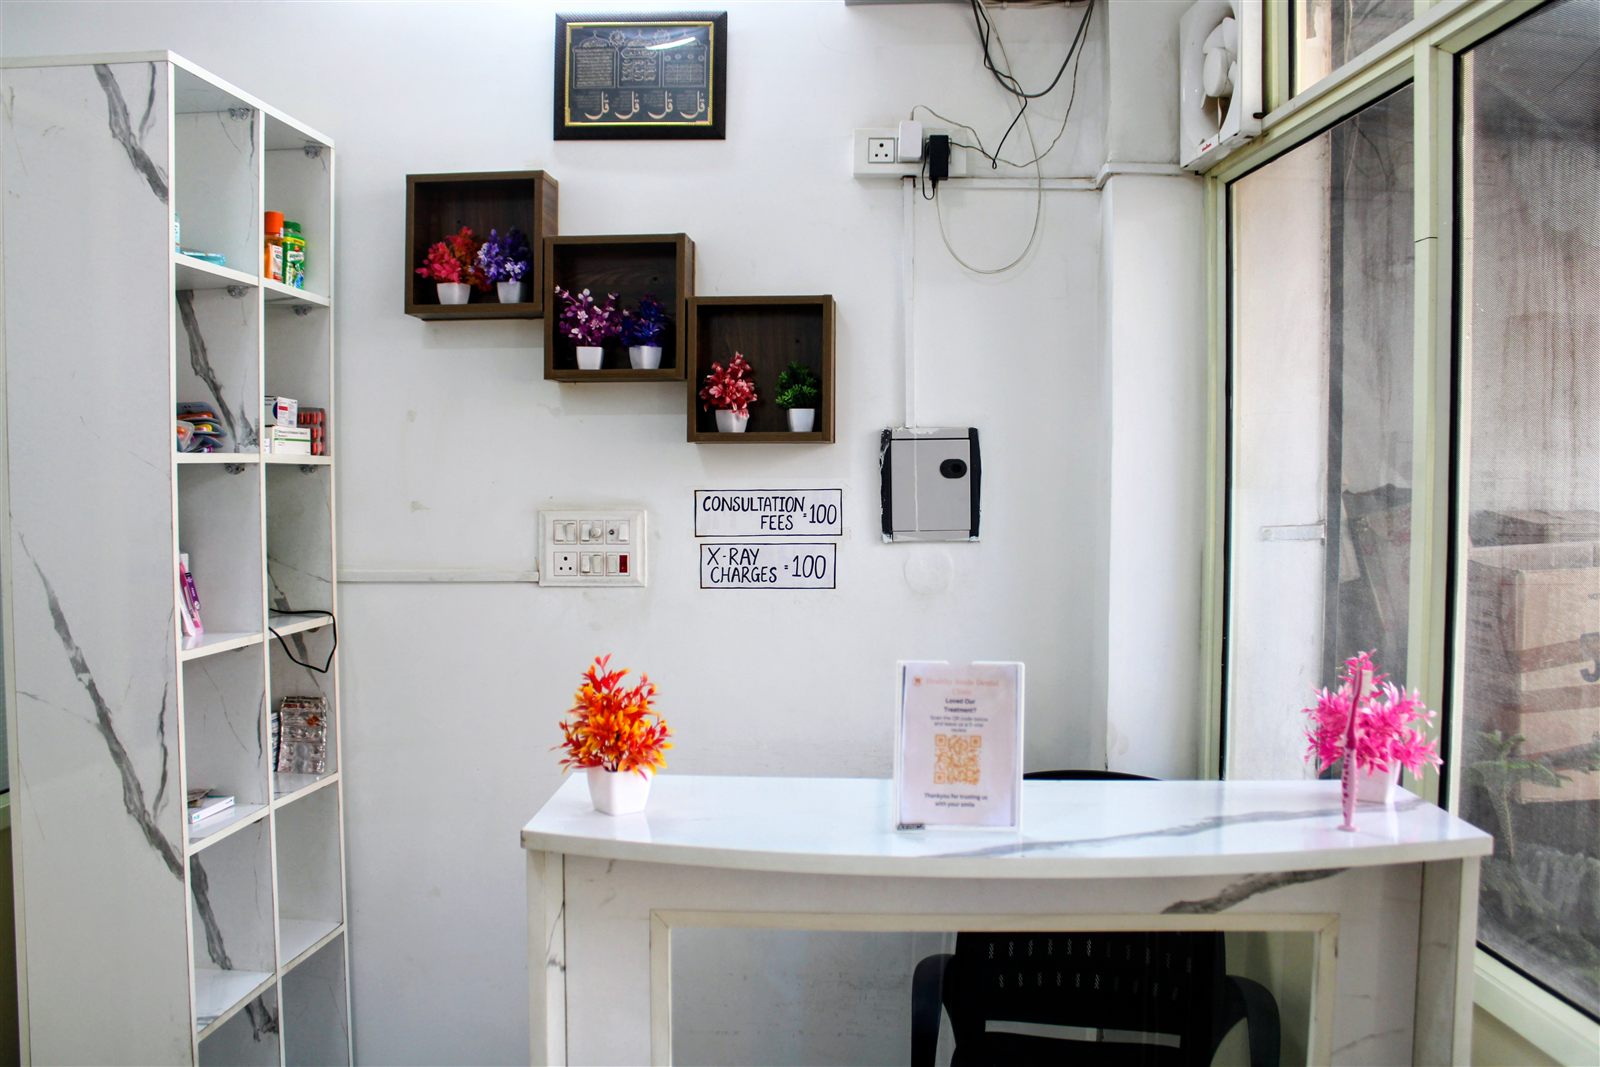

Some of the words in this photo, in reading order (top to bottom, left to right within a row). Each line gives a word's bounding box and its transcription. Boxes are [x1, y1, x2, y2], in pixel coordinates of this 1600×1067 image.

[702, 496, 805, 512] CONSULTATION
[760, 514, 793, 530] FEES
[707, 547, 760, 565] X-RAY
[710, 566, 777, 583] CHARGES
